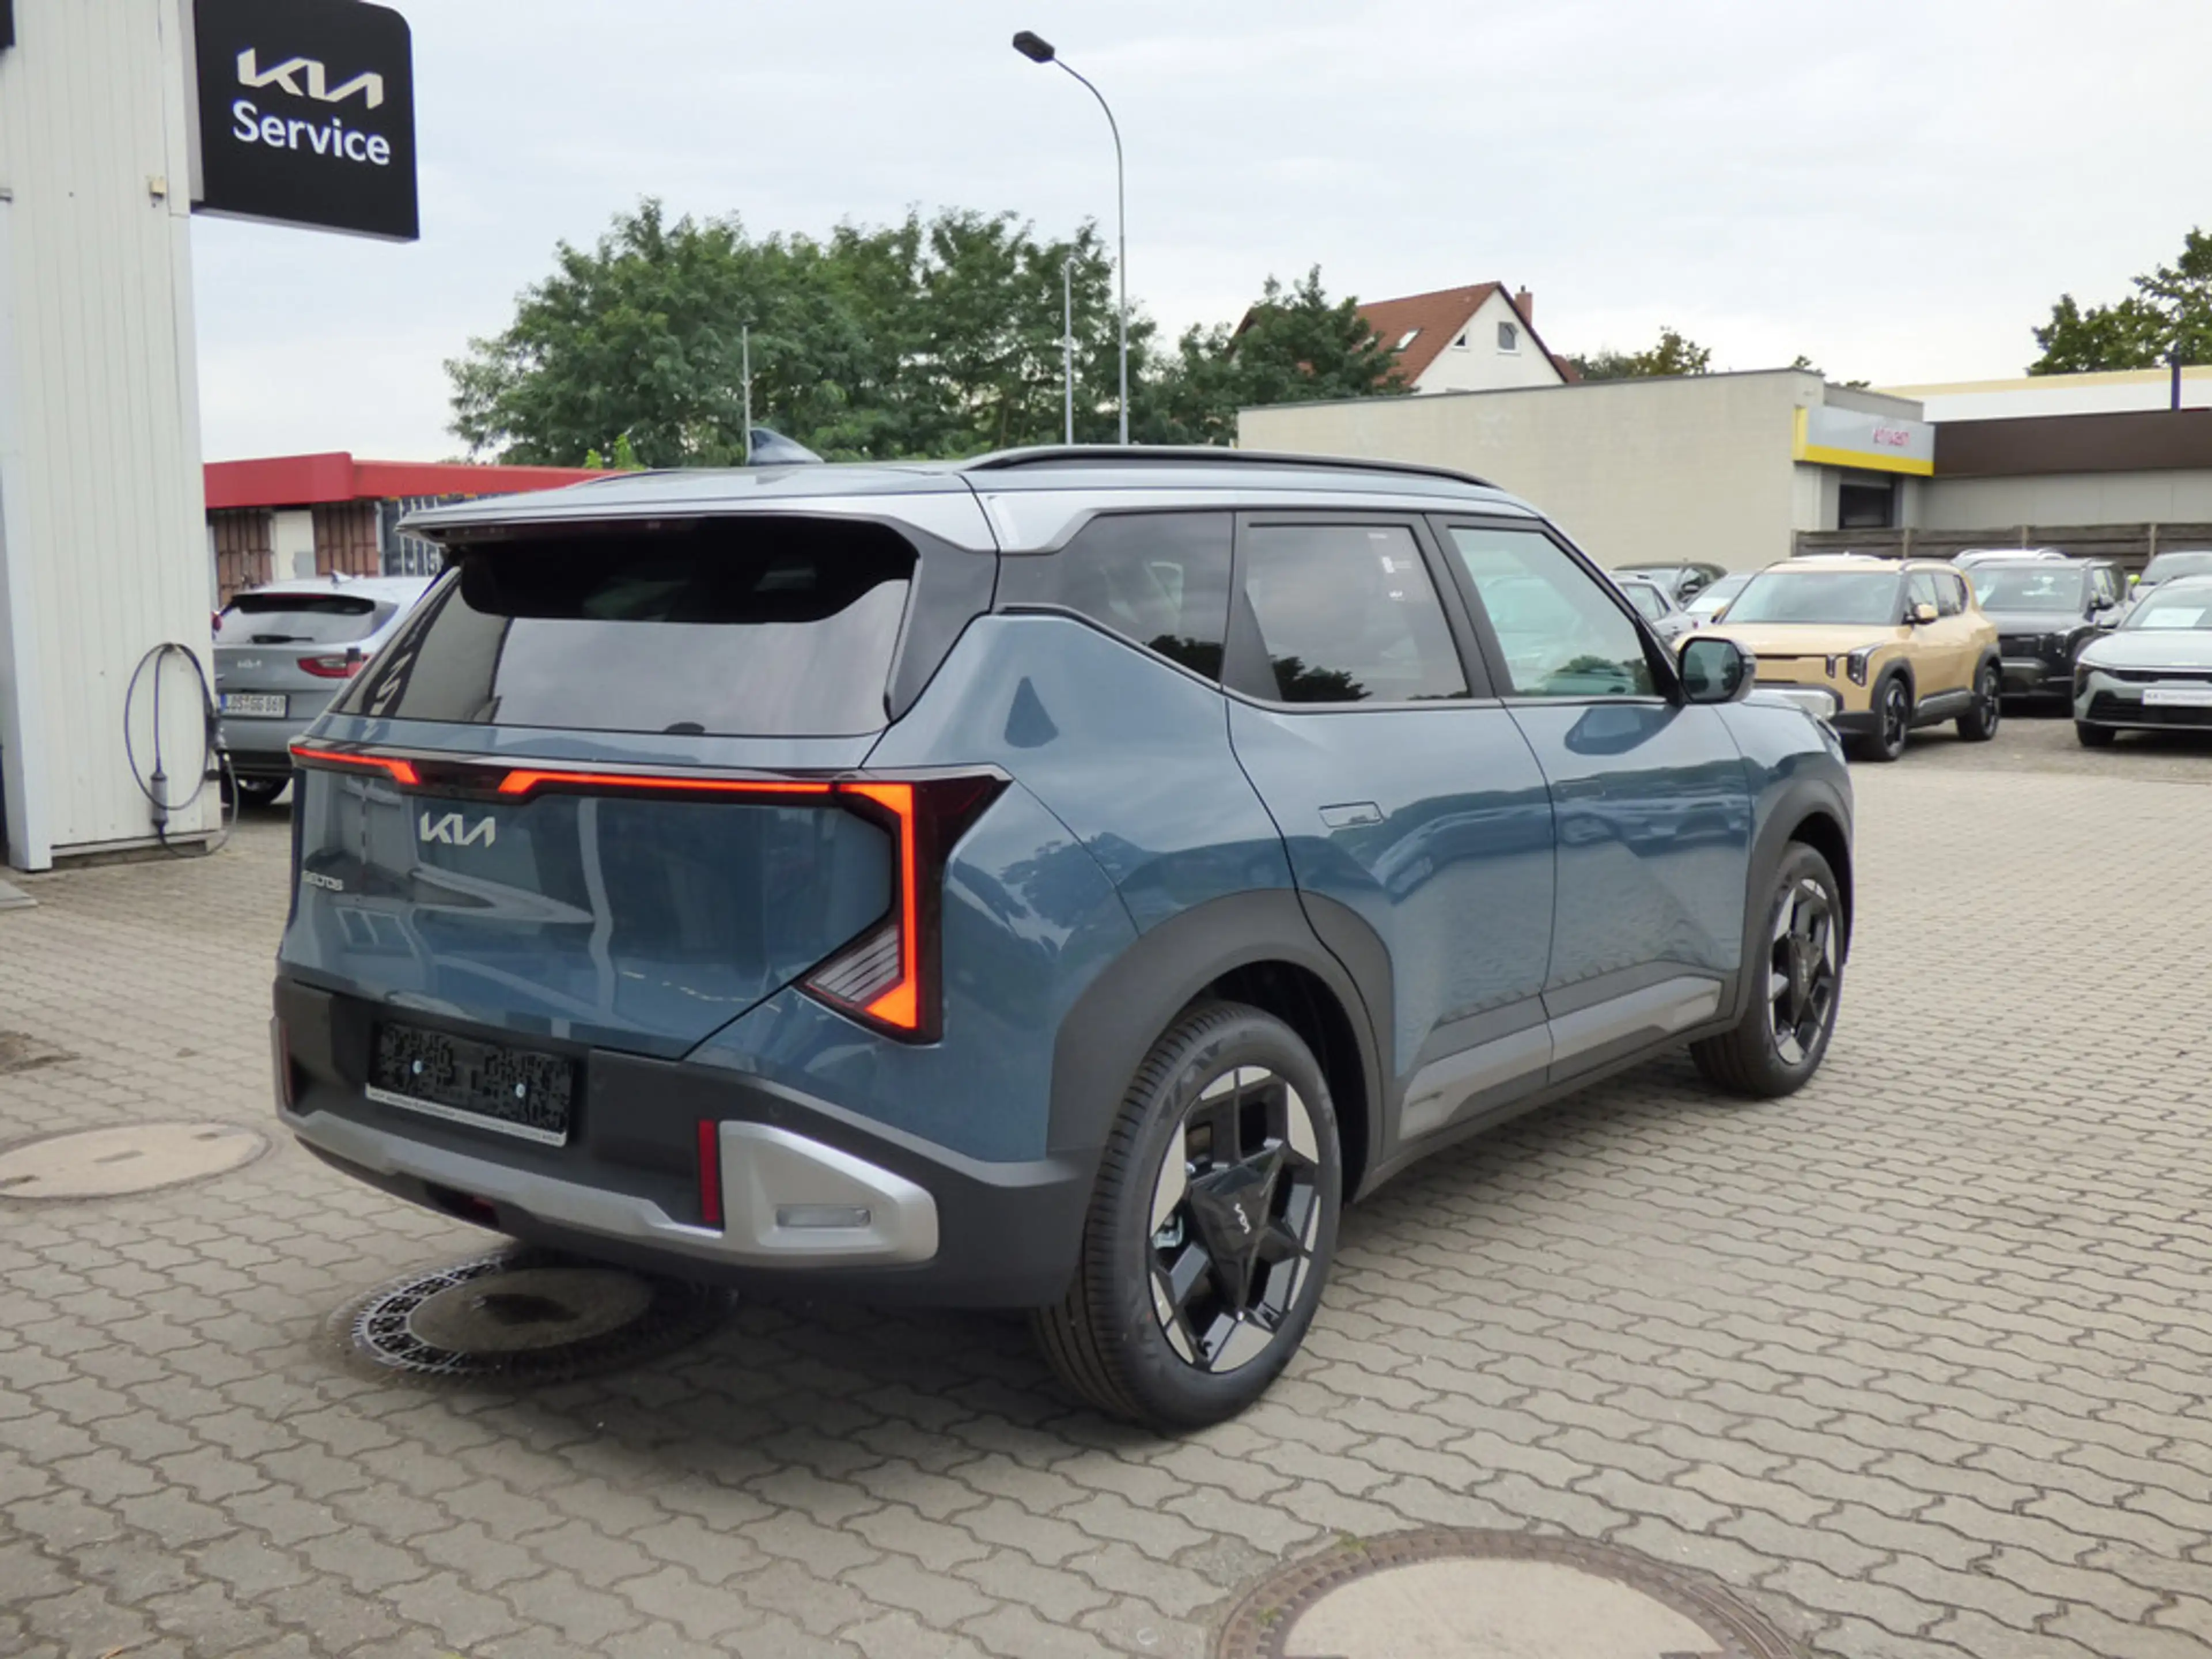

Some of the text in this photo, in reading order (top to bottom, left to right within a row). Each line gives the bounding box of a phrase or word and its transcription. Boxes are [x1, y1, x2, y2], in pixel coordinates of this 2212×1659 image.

[237, 47, 384, 110] KIA
[232, 99, 391, 166] Service
[419, 812, 497, 848] KIA
